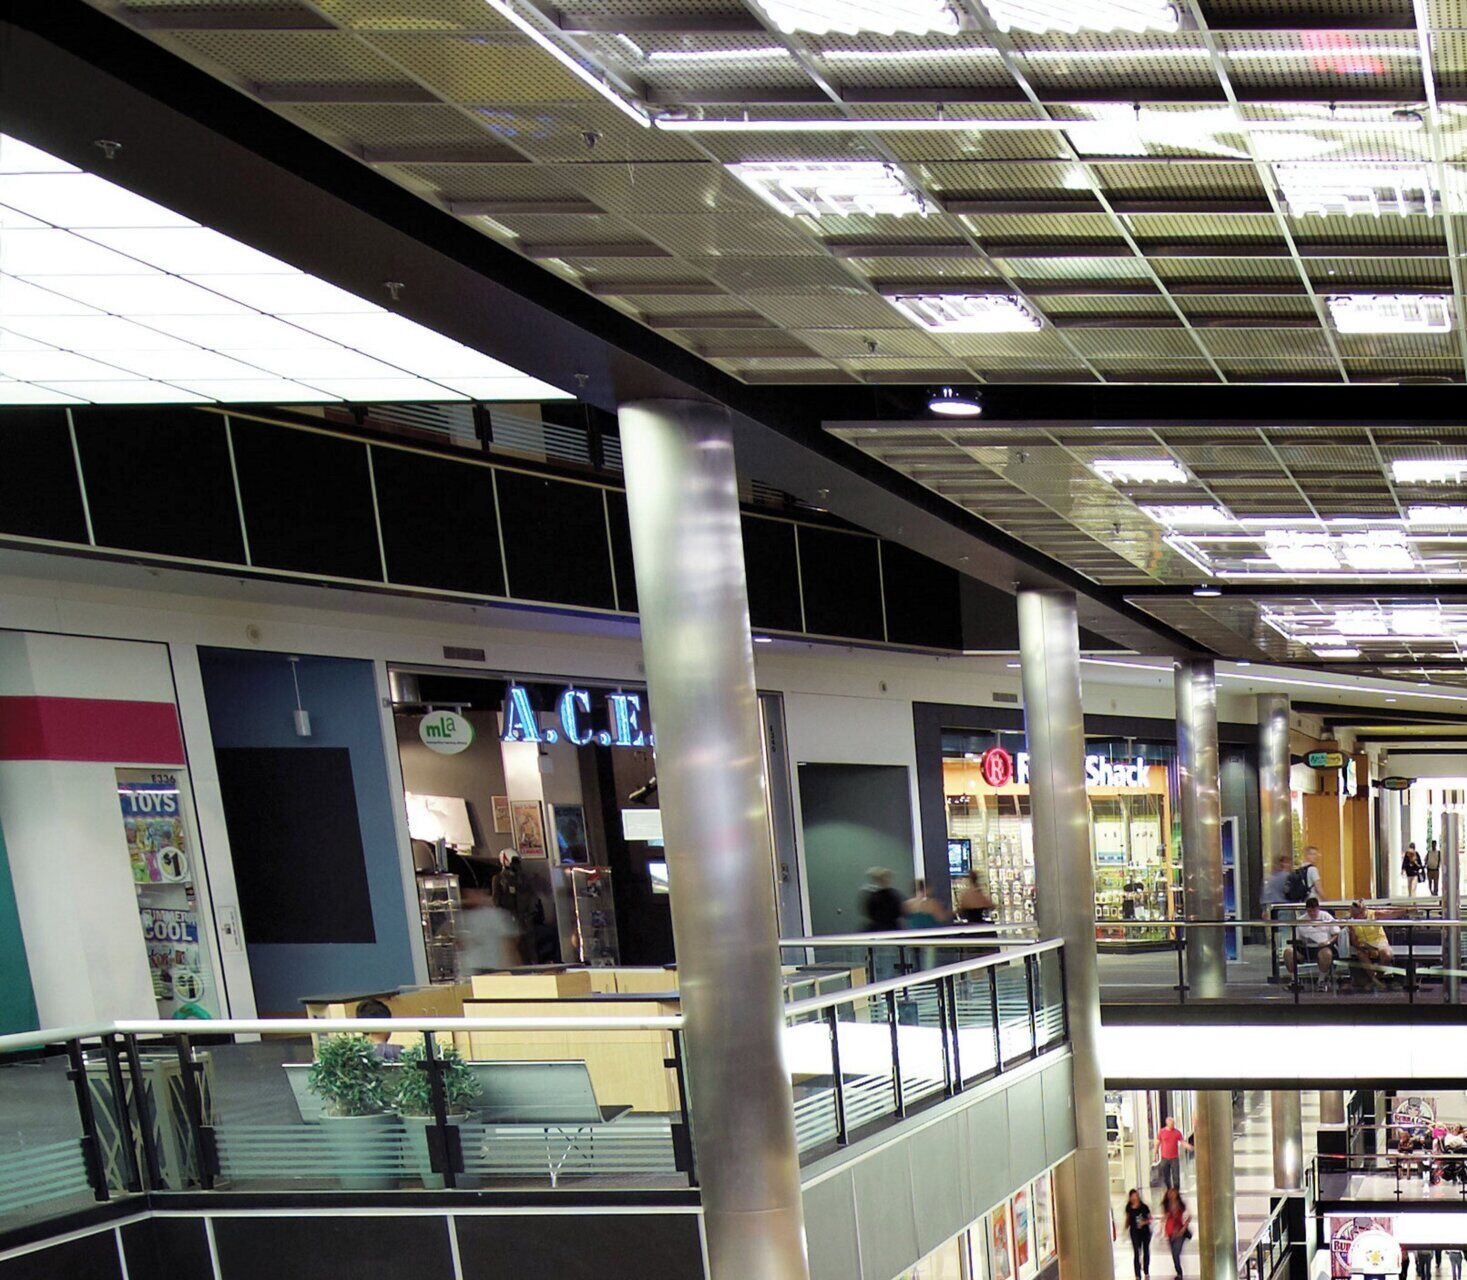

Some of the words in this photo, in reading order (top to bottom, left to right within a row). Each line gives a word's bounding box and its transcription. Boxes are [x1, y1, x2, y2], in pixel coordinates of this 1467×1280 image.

[129, 793, 176, 812] TOYS
[162, 852, 182, 878] $1
[144, 921, 193, 941] COOL
